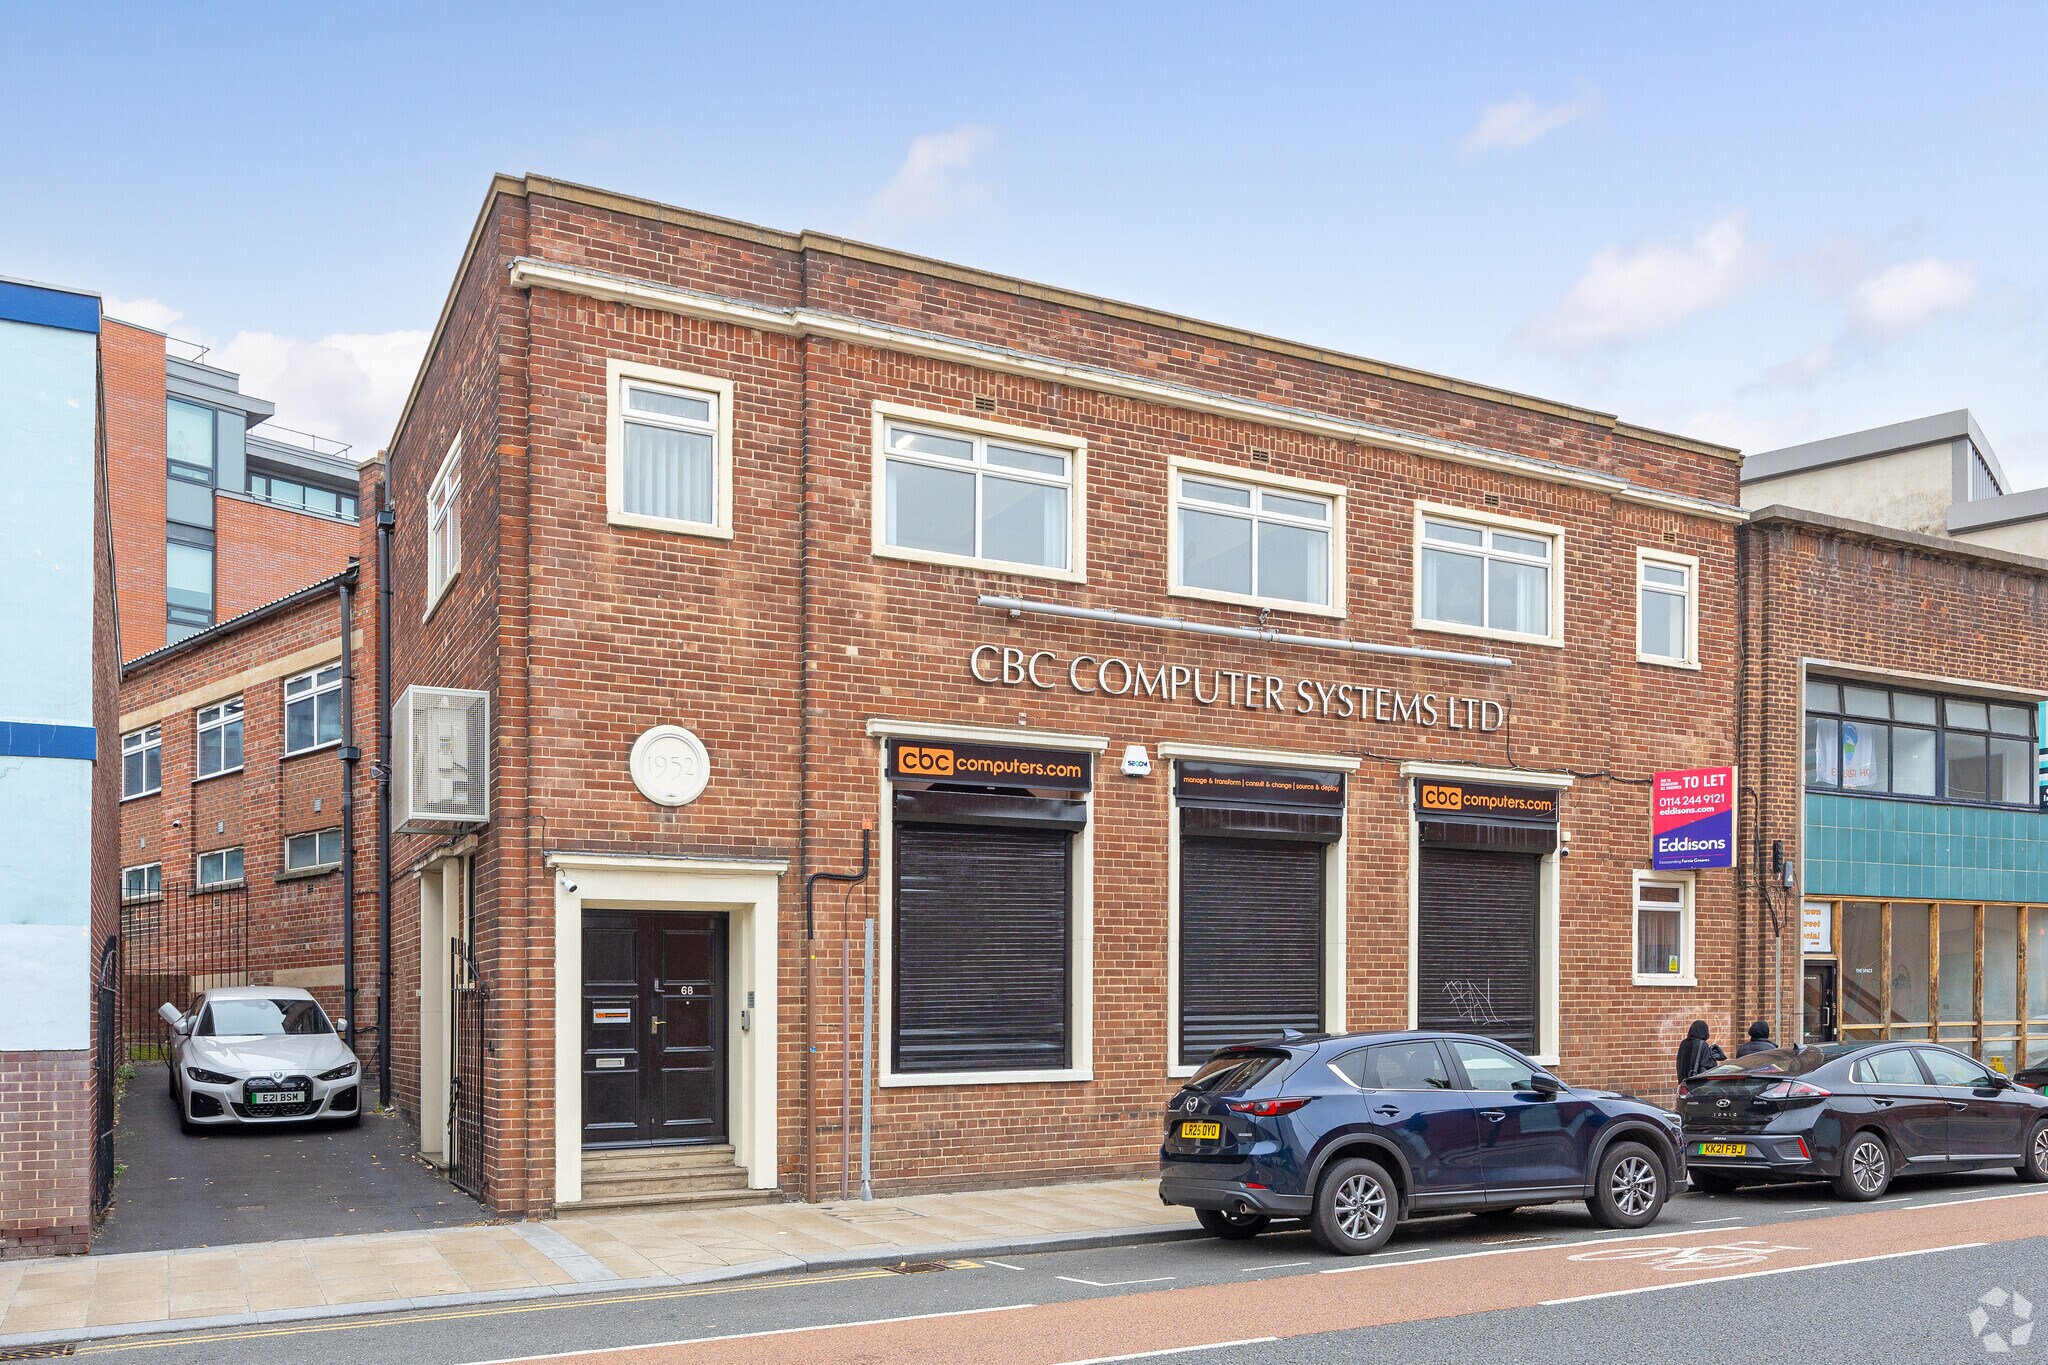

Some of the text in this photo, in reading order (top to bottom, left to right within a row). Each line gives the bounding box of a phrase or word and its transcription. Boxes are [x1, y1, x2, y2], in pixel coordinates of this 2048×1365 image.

[971, 645, 1504, 732] CBC COMPUTER SYSTEMS LTD
[647, 755, 694, 780] 1952
[902, 747, 1082, 778] cbc computers.com
[1183, 776, 1208, 785] manage
[1208, 777, 1214, 785] &
[1214, 777, 1242, 786] transform
[1245, 779, 1264, 788] consult
[1271, 780, 1292, 790] change
[1295, 783, 1314, 791] source
[1320, 783, 1339, 793] deploy
[1683, 774, 1726, 788] TO LET
[1425, 786, 1552, 811] cbc computers.com
[1660, 793, 1725, 807] 0114 244 9121
[1660, 806, 1714, 815] eddisons.com
[1659, 837, 1726, 852] Eddisons
[681, 986, 693, 995] 68
[263, 1092, 299, 1103] E21 BSM
[1185, 1124, 1217, 1136] LR25 OYO
[1705, 1145, 1743, 1154] KK21 FBJ
